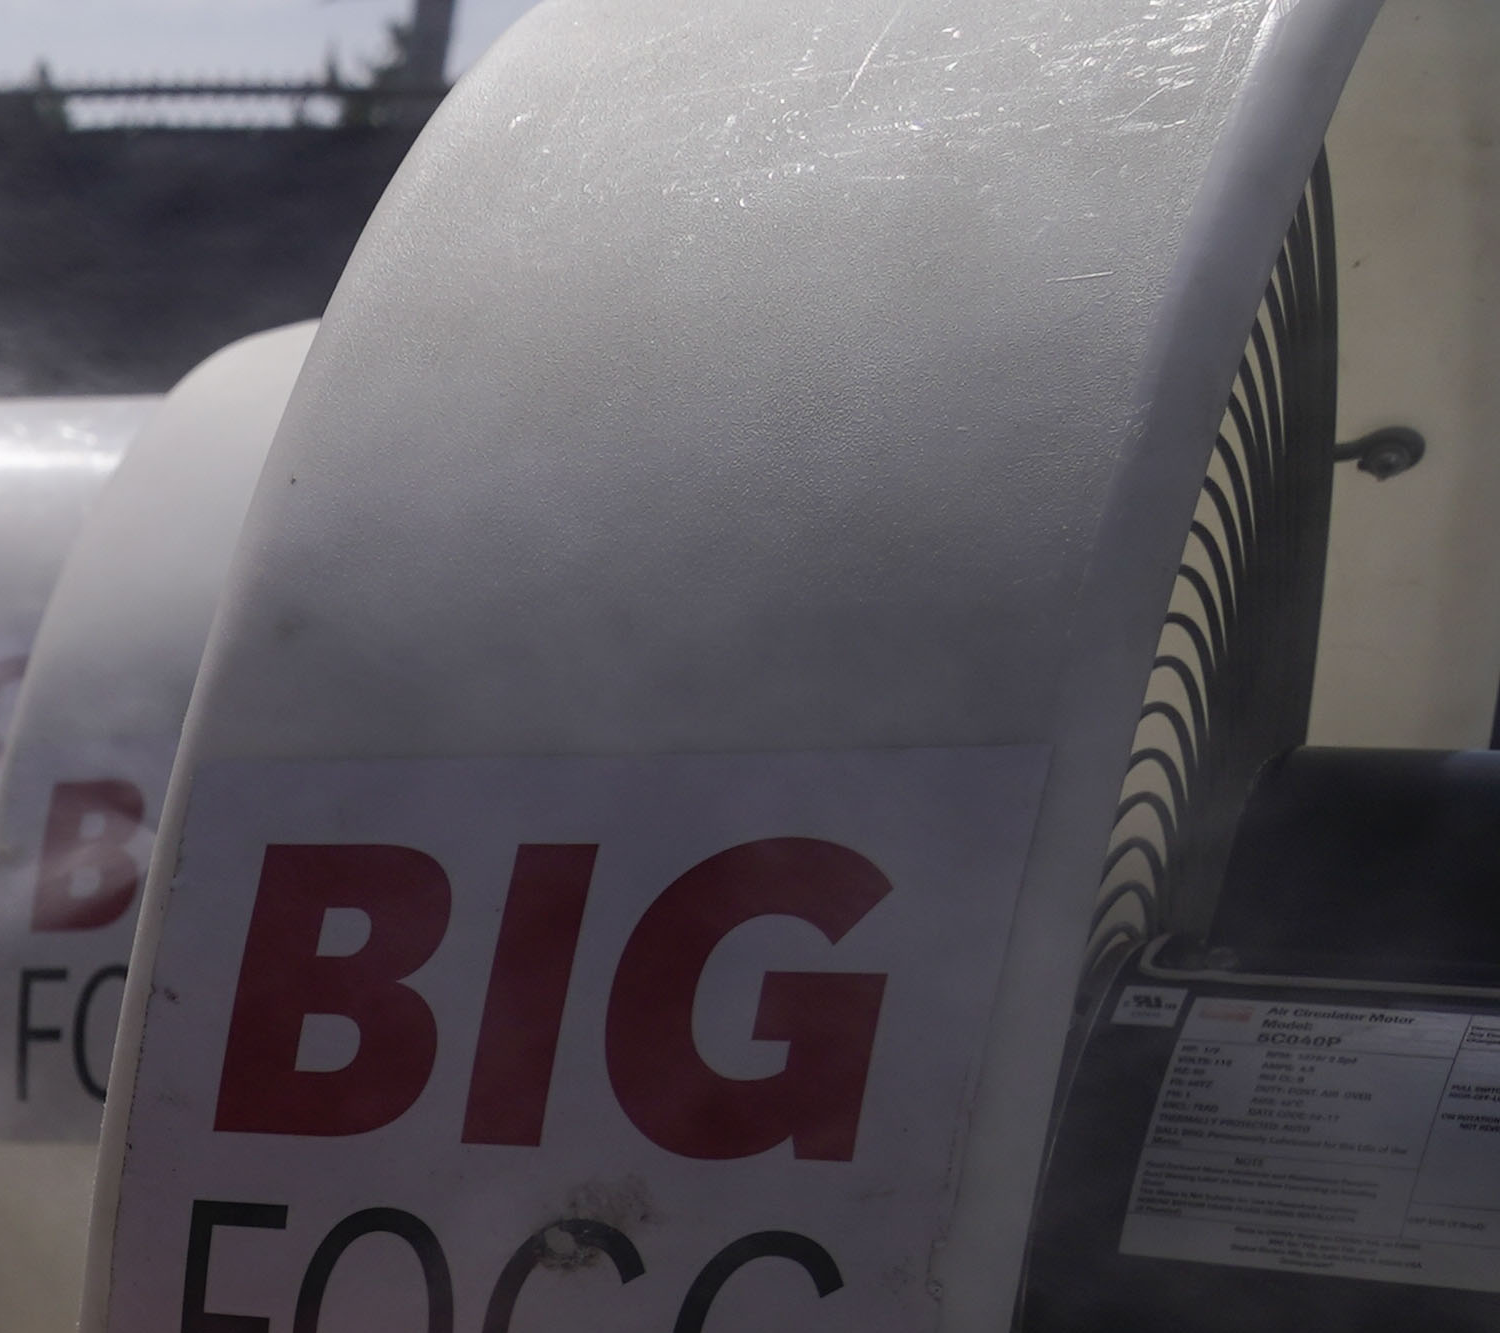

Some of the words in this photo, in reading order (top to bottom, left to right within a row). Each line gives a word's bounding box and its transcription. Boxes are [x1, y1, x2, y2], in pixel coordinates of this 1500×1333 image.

[213, 836, 895, 1162] BIG
[1266, 1006, 1289, 1016] Air
[1293, 1008, 1366, 1021] Circulator
[1368, 1013, 1416, 1025] Motor
